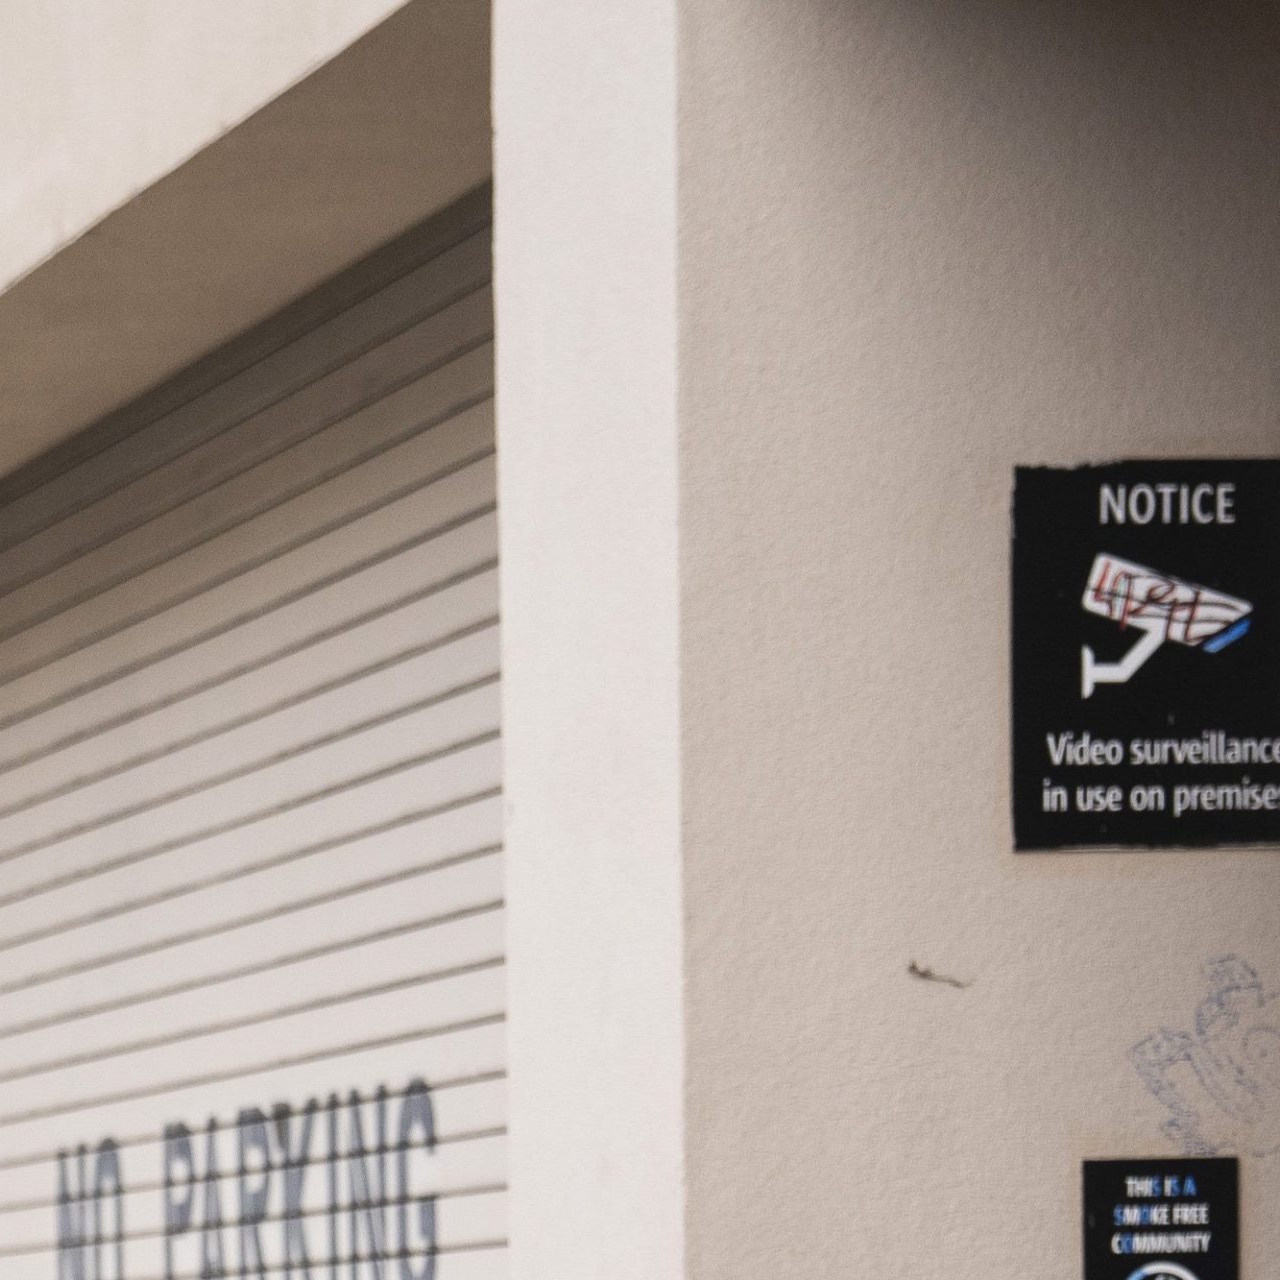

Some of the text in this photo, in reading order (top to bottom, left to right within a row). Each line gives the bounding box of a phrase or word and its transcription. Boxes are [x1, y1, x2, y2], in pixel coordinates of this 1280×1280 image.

[1099, 483, 1236, 524] NOTICE
[1046, 731, 1123, 765] Video
[1043, 775, 1280, 817] in use on premise
[1125, 1175, 1197, 1197] THIS IS A
[1113, 1202, 1210, 1226] SMOKE FREE
[1110, 1231, 1212, 1254] COMMUNITY
